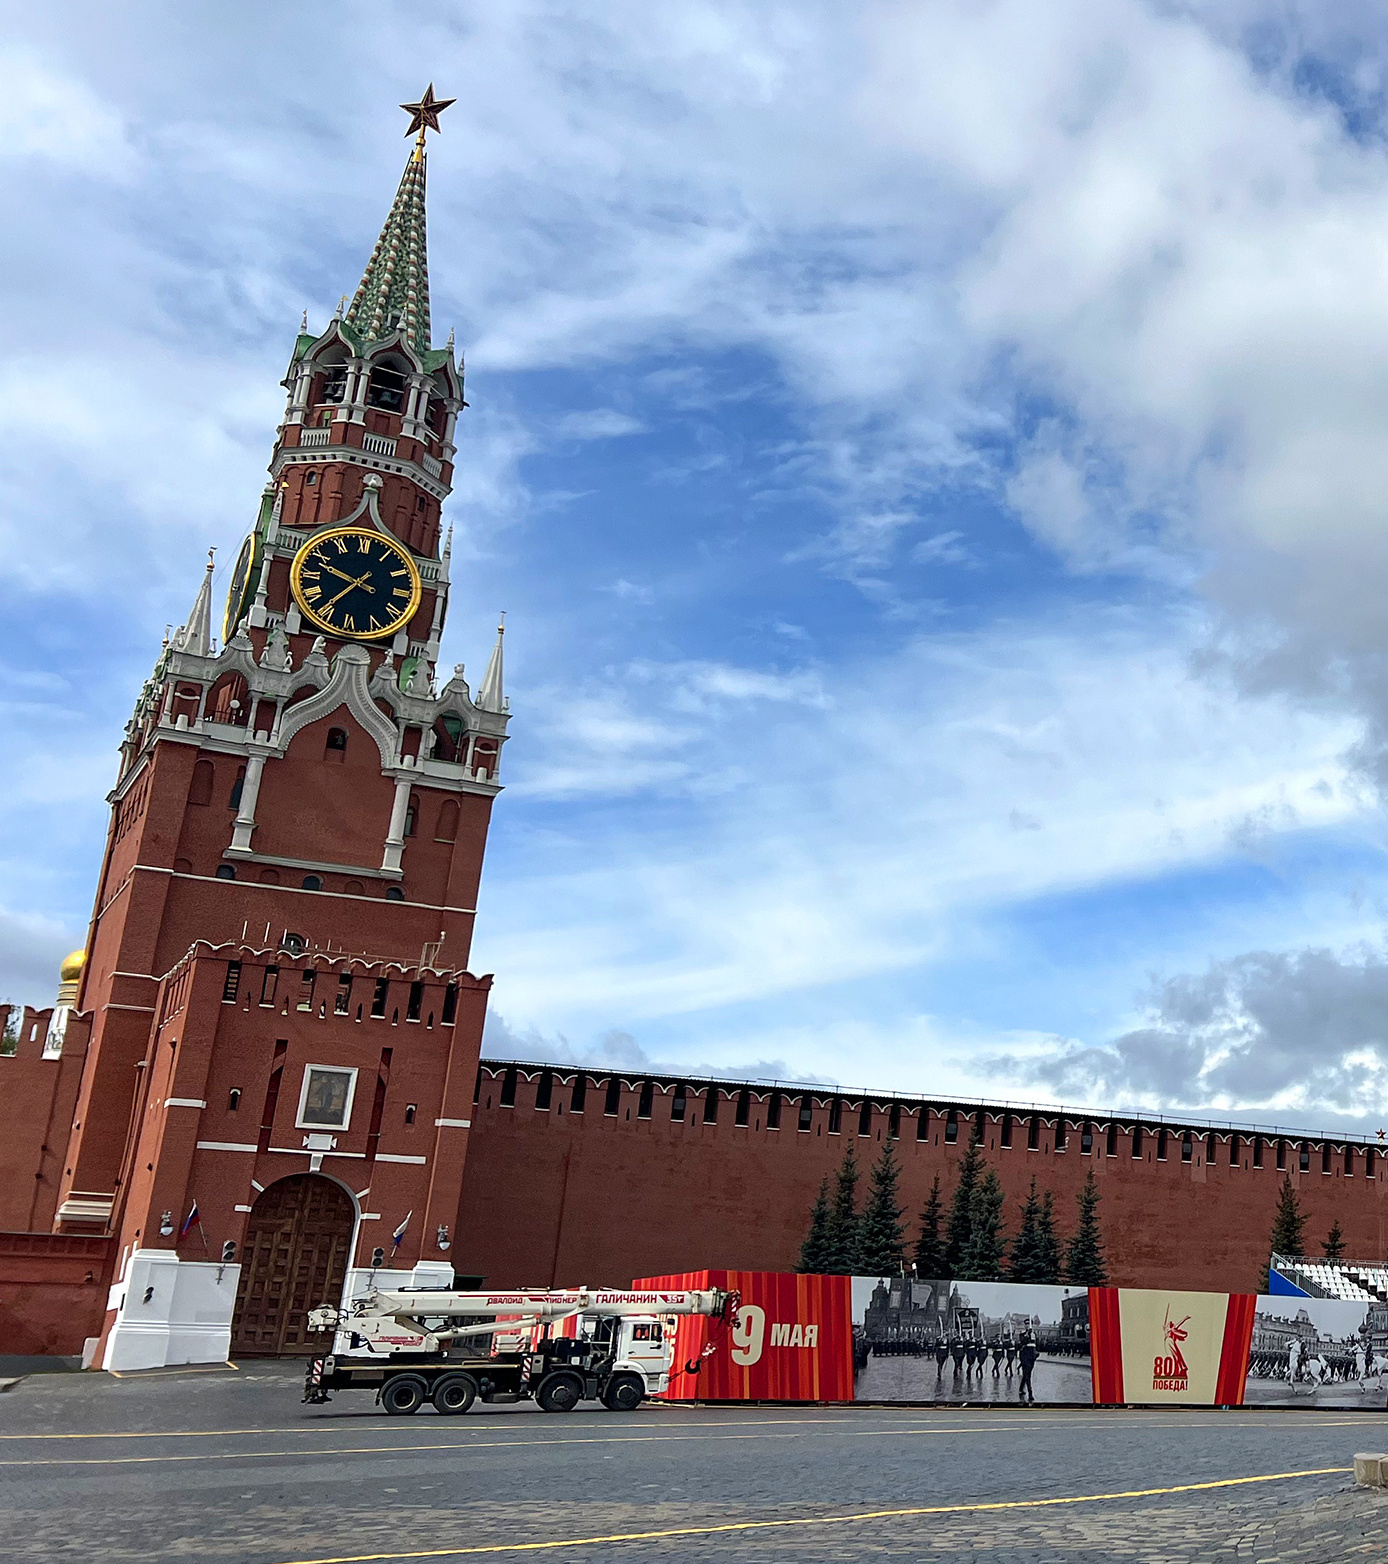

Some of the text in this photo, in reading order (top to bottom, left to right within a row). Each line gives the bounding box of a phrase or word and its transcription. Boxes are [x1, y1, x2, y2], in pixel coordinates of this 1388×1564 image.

[596, 1294, 657, 1304] ГАЛИЧАНИН
[731, 1305, 819, 1366] 9 МАЯ
[1153, 1356, 1173, 1377] 80
[1152, 1380, 1188, 1392] ПОБЕДА!
